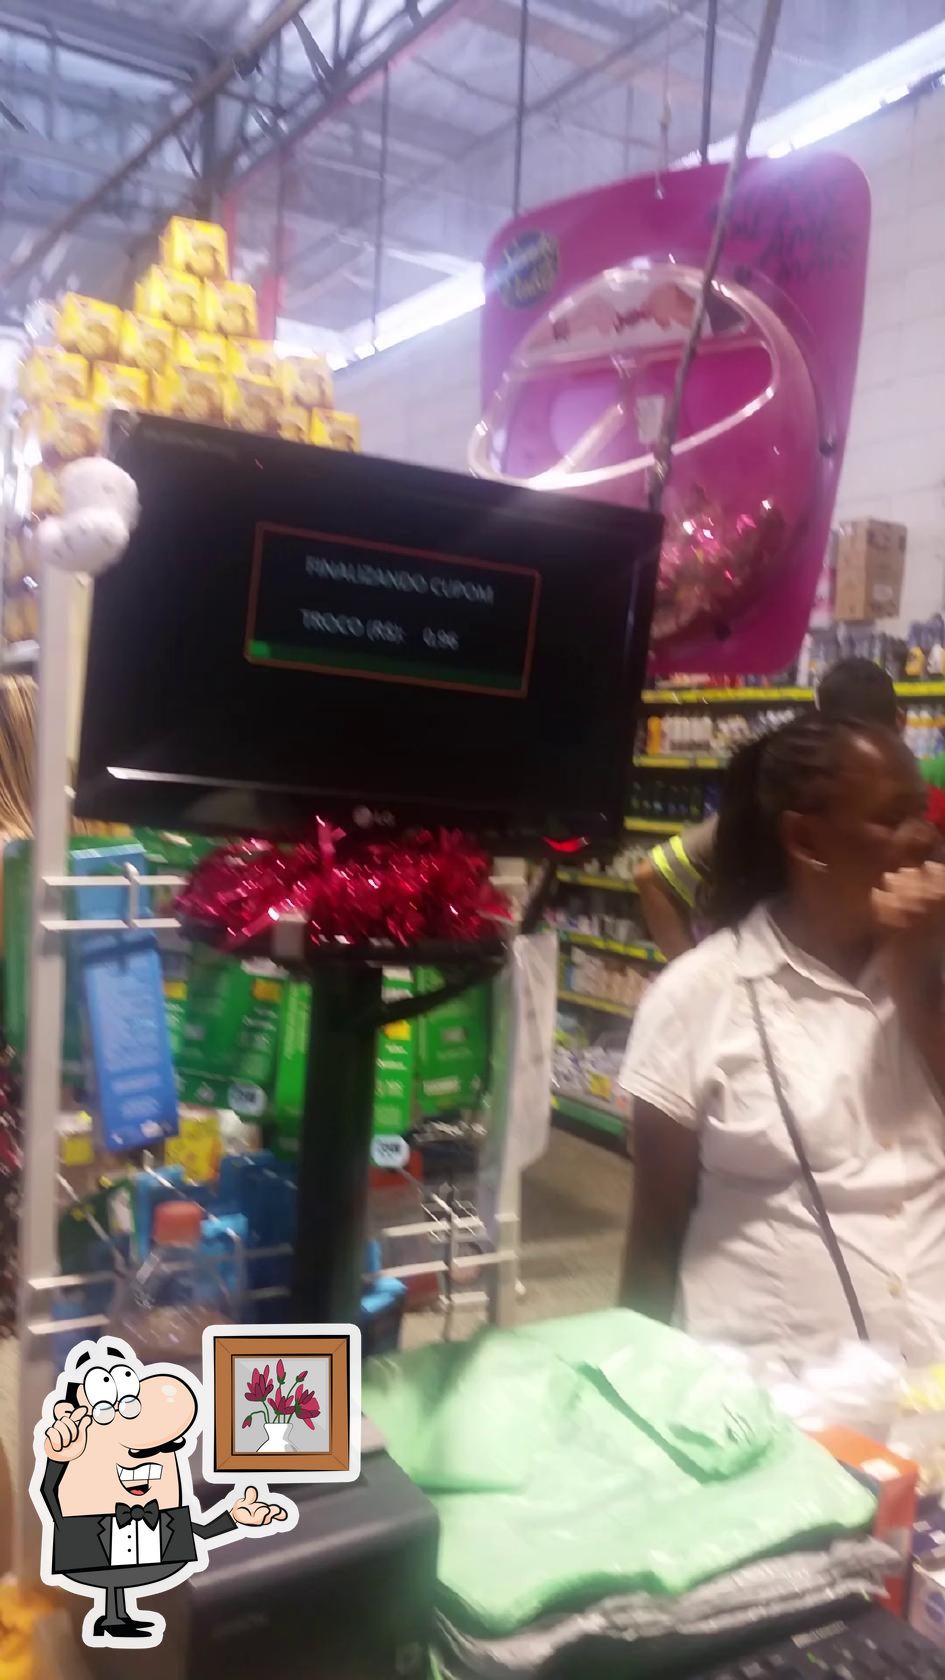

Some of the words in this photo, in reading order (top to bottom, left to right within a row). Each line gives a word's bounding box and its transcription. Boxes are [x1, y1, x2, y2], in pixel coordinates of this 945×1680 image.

[305, 555, 428, 594] FINALIZANDO
[430, 576, 494, 604] CUPOM
[300, 608, 365, 637] TROCO
